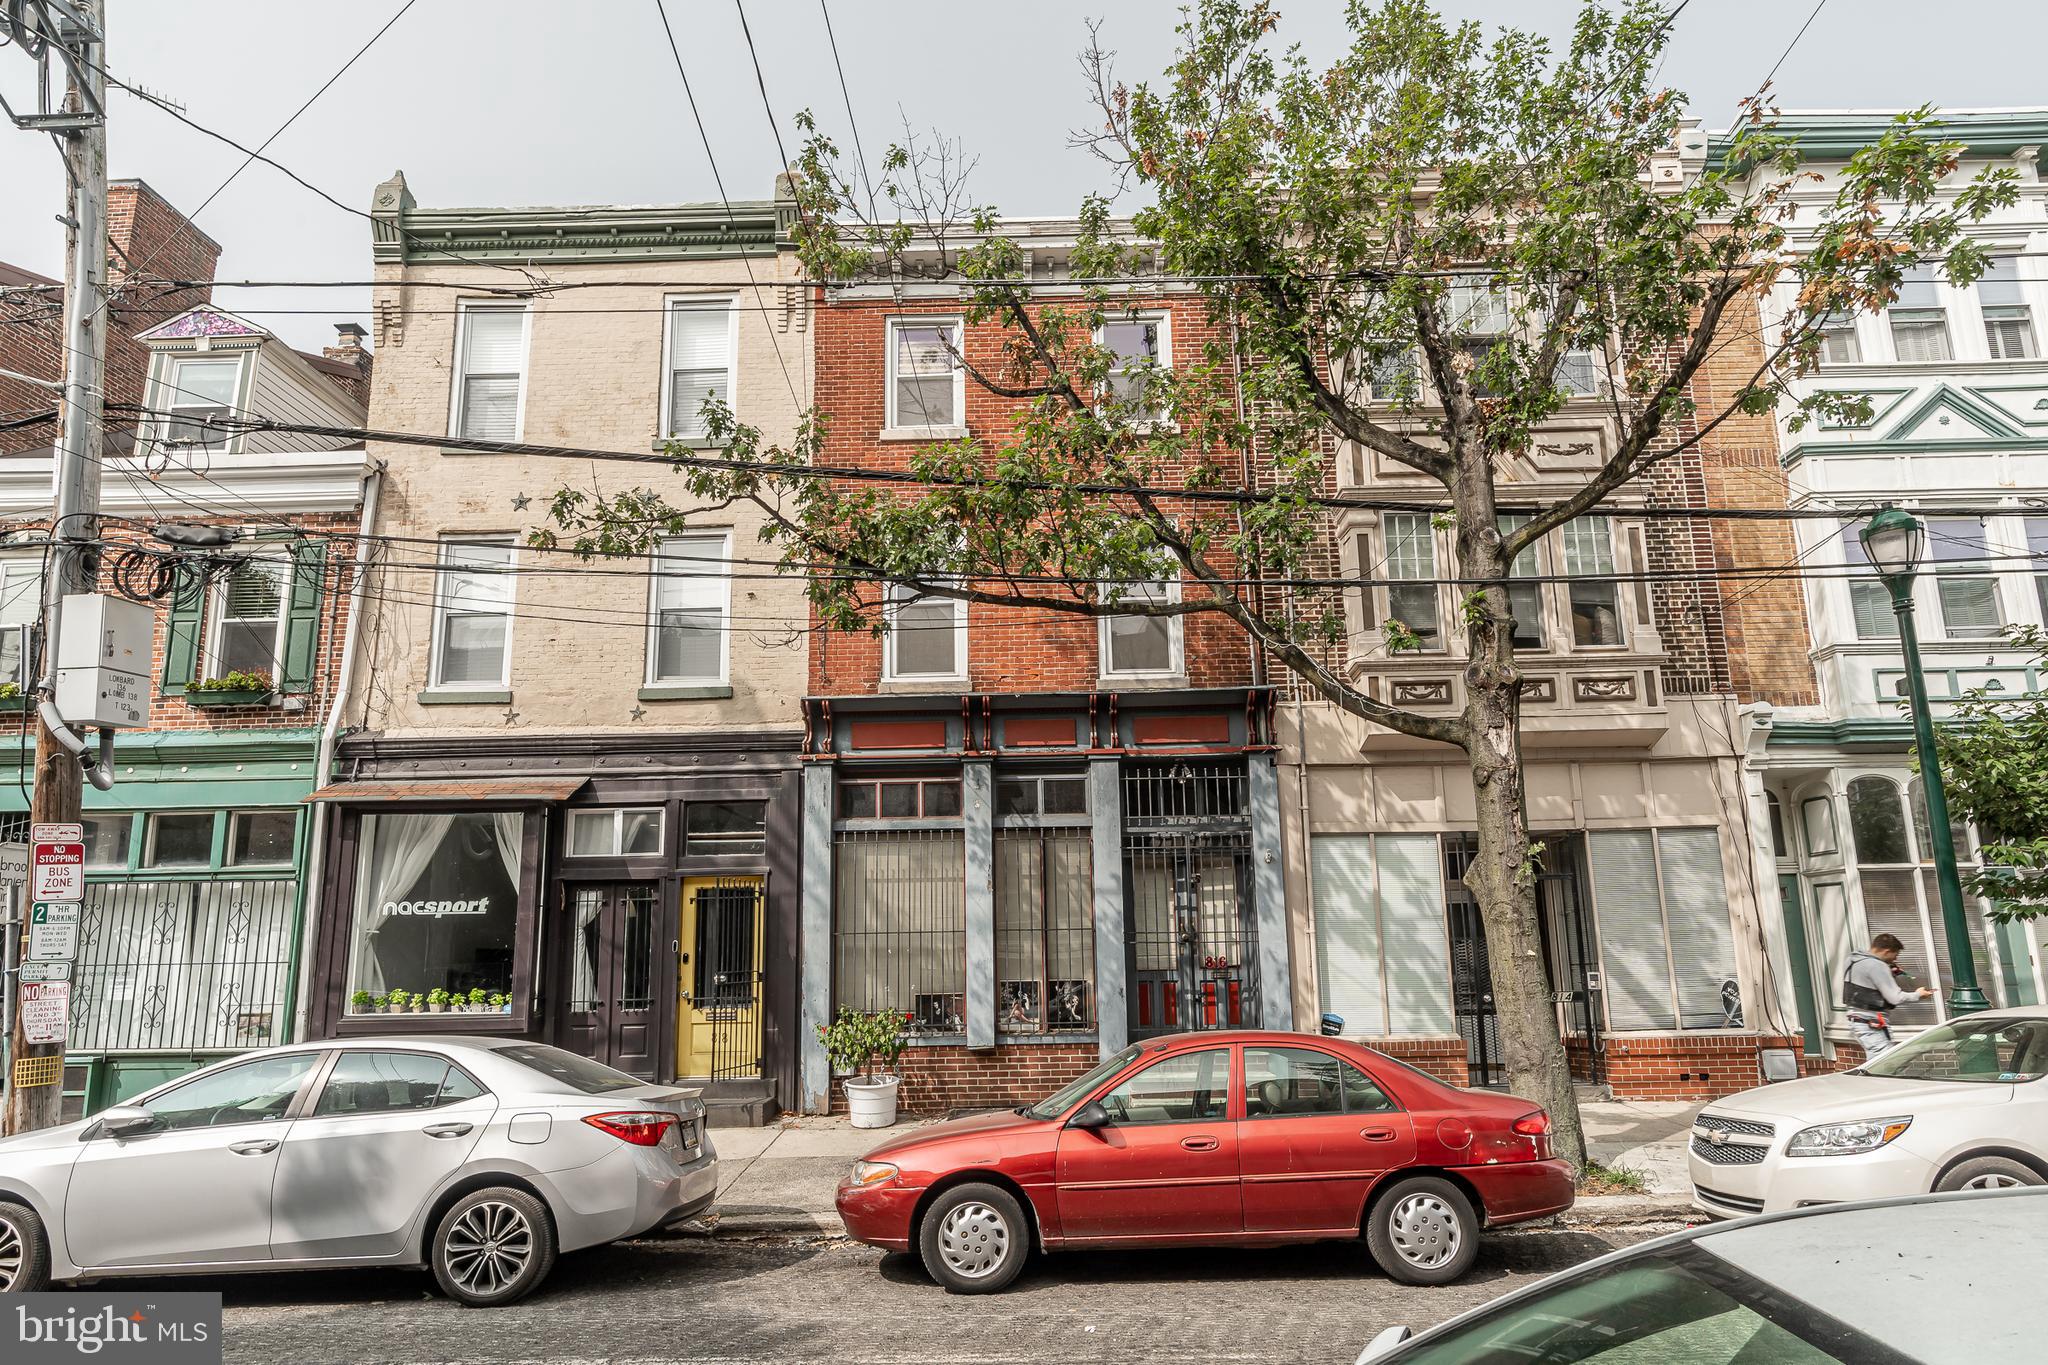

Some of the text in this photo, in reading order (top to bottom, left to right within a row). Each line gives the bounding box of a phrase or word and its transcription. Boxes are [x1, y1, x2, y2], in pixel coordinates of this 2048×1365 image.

[109, 674, 135, 685] LOMBARD
[128, 693, 138, 701] 138
[53, 845, 66, 854] NO
[0, 856, 27, 872] broo
[39, 854, 80, 863] STOPPING
[48, 866, 70, 877] BUS
[44, 877, 73, 888] ZONE
[382, 896, 490, 919] nacsport
[35, 905, 70, 922] 2 HR
[48, 914, 77, 922] PARKING
[23, 985, 67, 1000] NO PARKING
[1551, 992, 1572, 1001] 814
